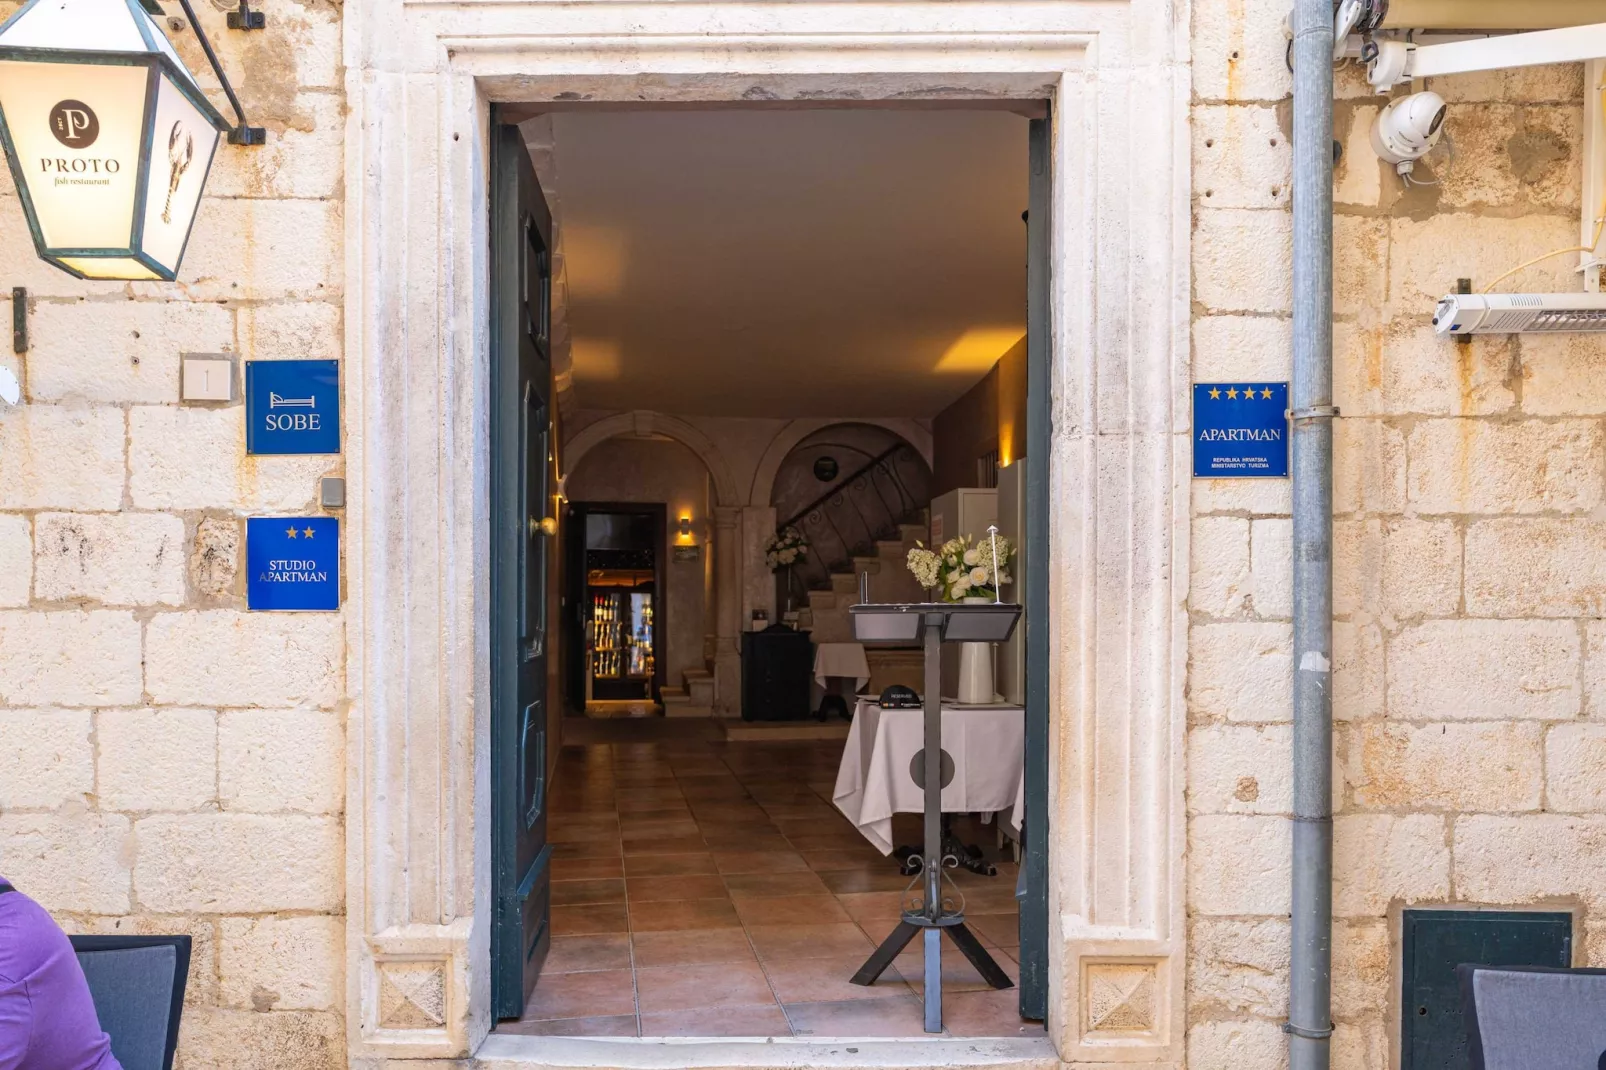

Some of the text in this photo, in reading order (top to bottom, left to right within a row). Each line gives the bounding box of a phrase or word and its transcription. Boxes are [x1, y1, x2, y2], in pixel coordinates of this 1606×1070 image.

[40, 157, 120, 174] PROTO
[54, 176, 110, 188] fish restaurant
[265, 413, 322, 431] SOBE
[1198, 428, 1282, 441] APARTMAN
[269, 560, 316, 571] STUDIO
[259, 571, 328, 582] APARTMAN
